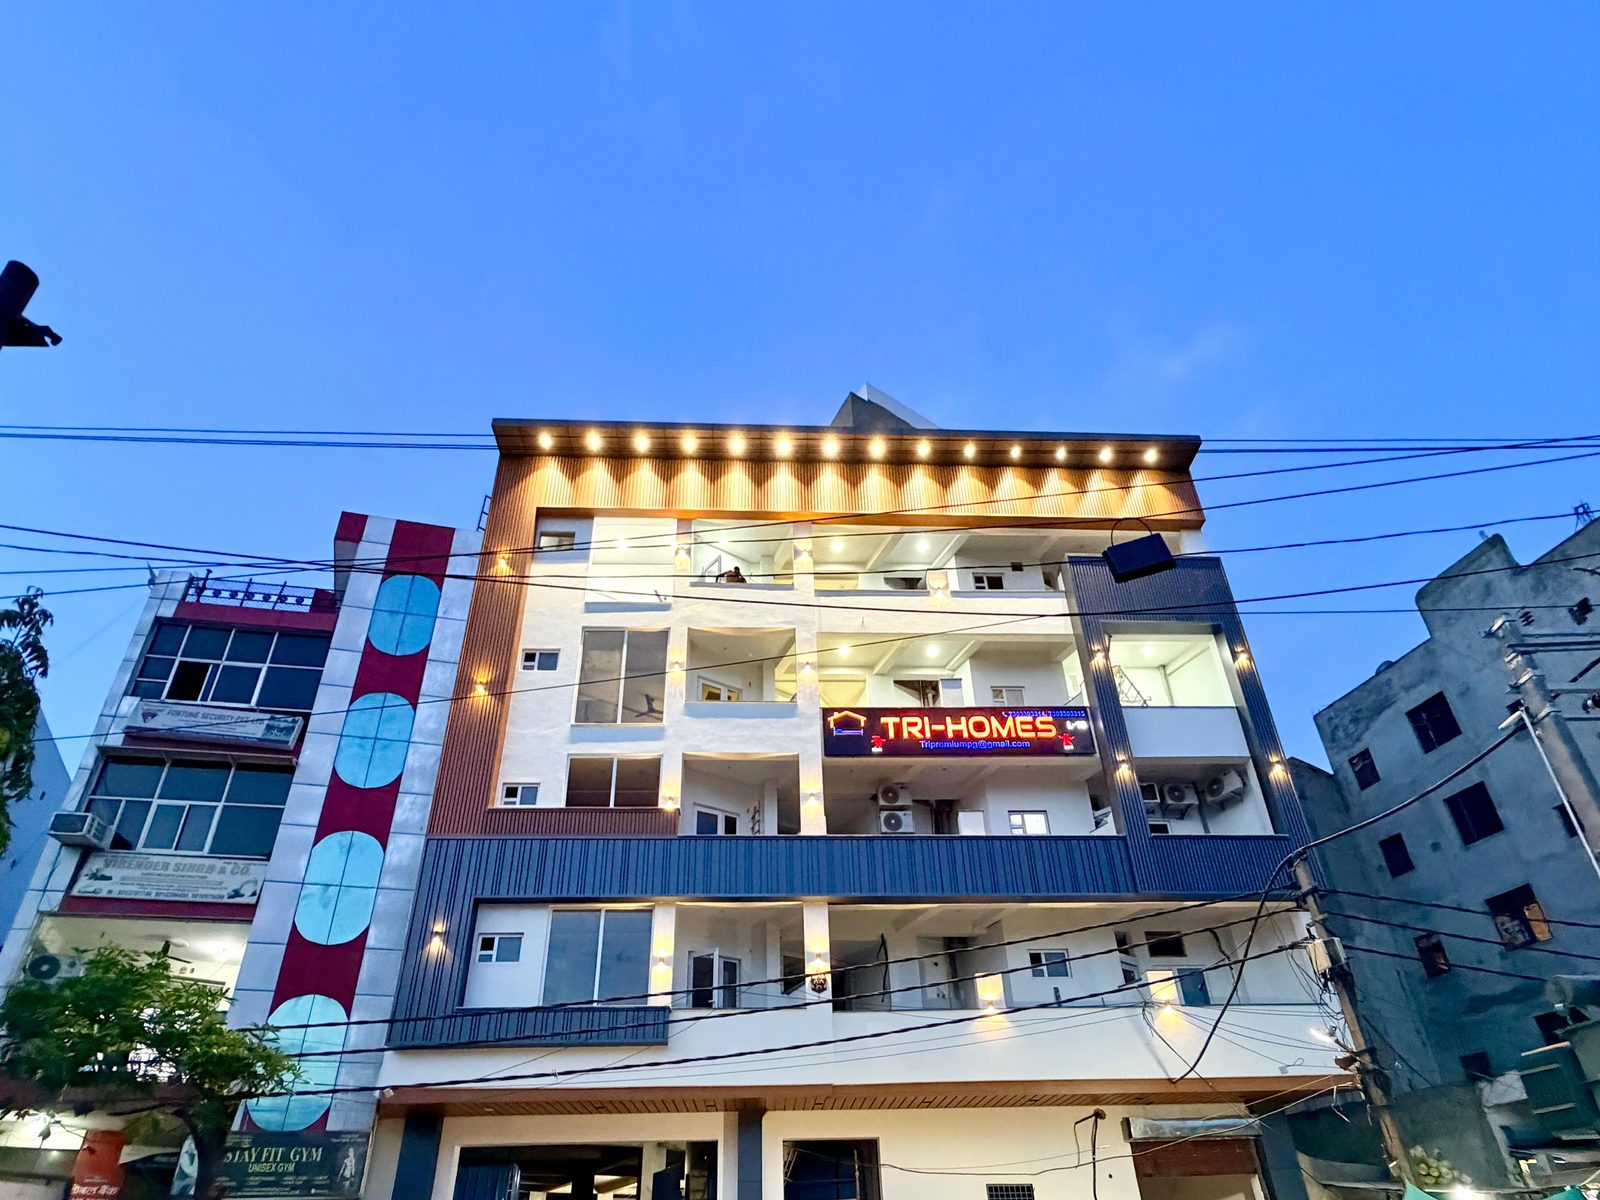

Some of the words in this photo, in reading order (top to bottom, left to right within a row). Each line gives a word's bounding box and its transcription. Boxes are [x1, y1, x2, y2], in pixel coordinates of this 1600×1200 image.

[200, 712, 234, 722] SECURITY
[880, 715, 1058, 740] TRI-HOMES
[103, 858, 171, 873] VIRENDER
[260, 1147, 284, 1162] FIT
[289, 1146, 323, 1162] GYM
[248, 1162, 277, 1173] UNISEX
[277, 1162, 296, 1173] GYM
